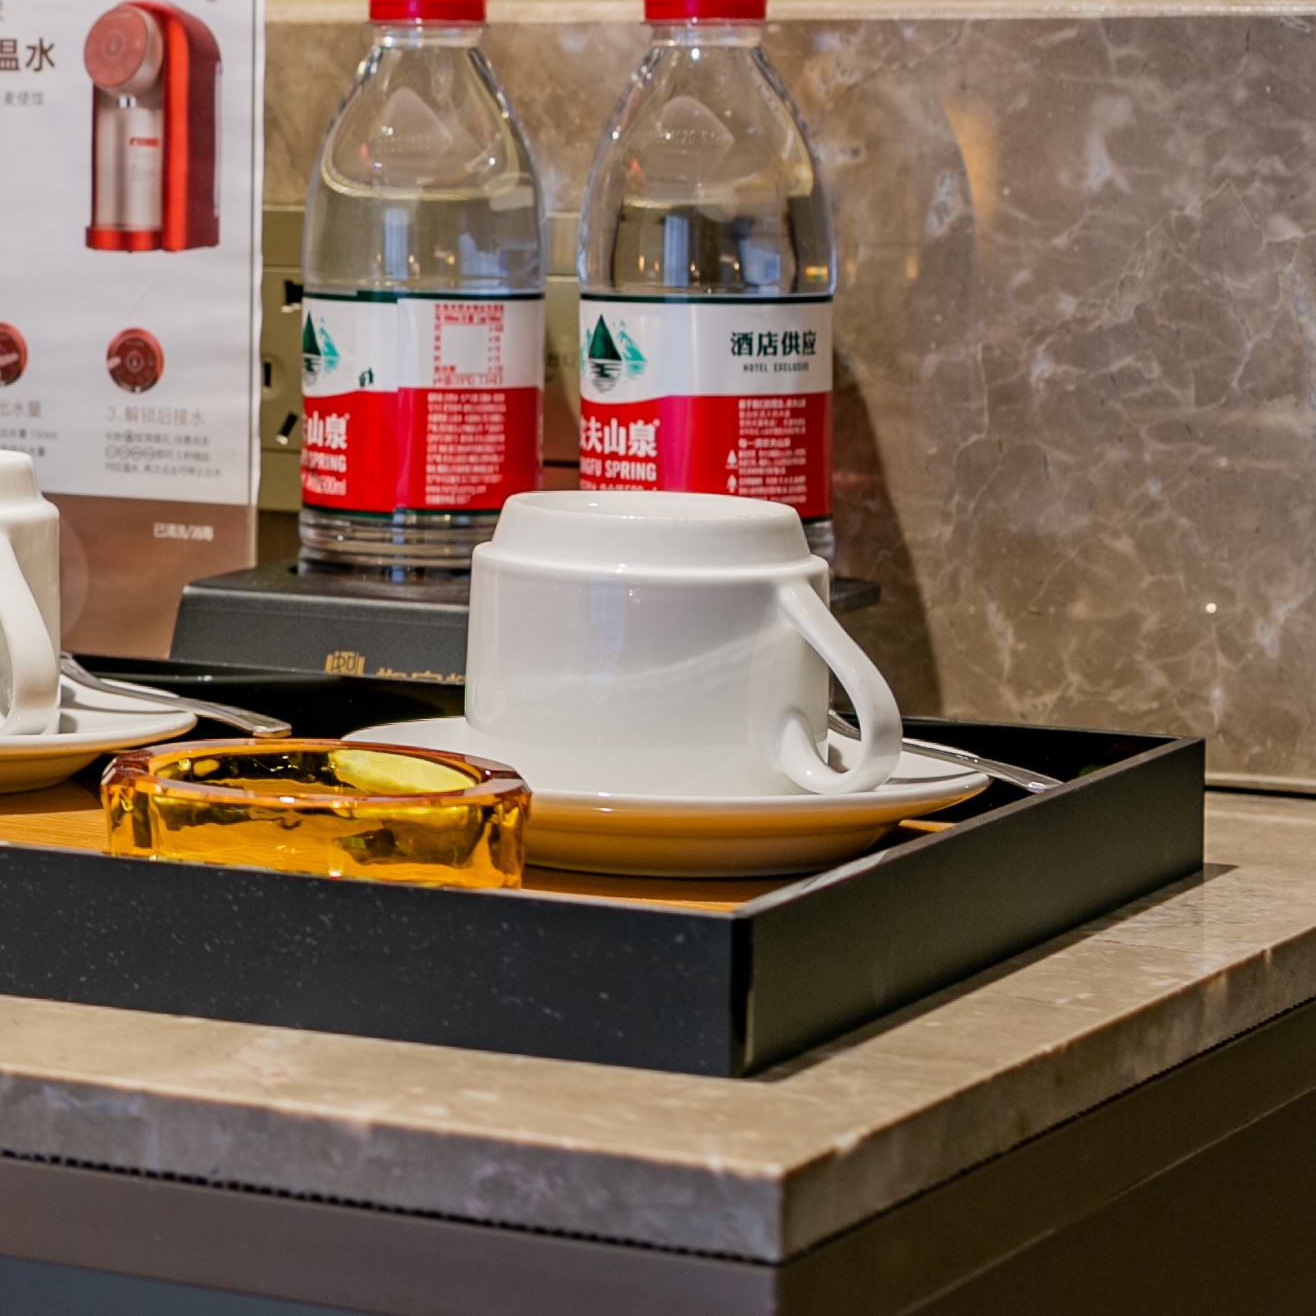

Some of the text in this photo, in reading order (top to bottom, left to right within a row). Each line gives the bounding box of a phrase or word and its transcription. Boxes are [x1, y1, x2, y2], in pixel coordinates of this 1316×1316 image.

[730, 330, 817, 357] 酒店供应
[742, 362, 769, 373] HOTEL
[302, 410, 348, 451] 山泉
[604, 459, 658, 483] SPRING
